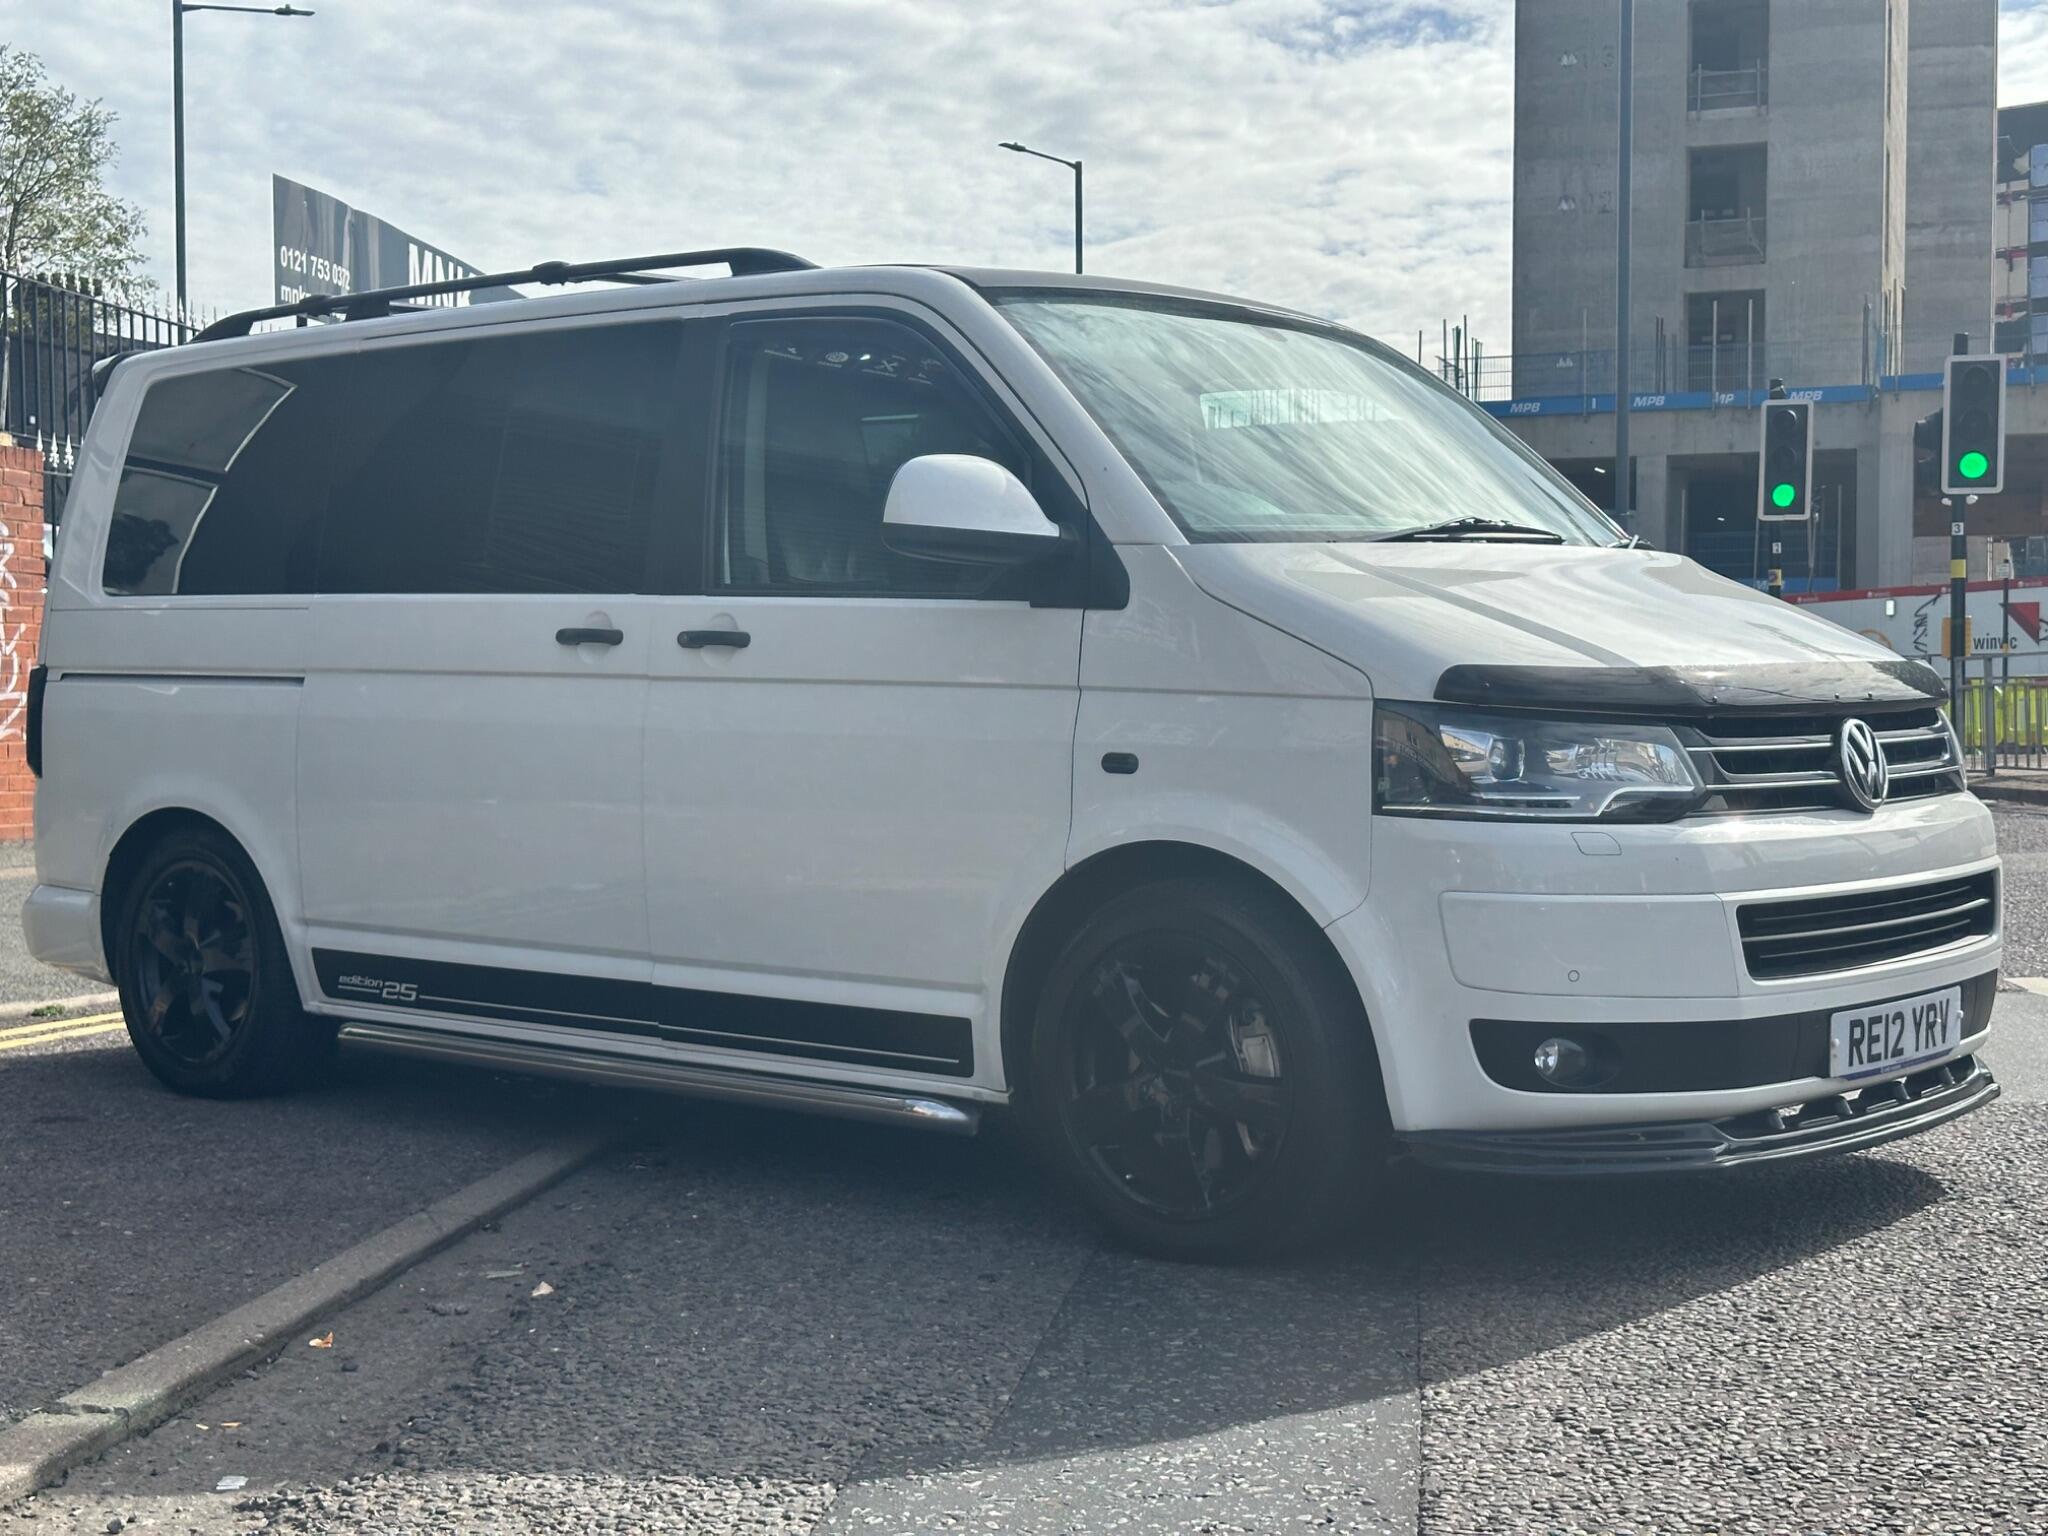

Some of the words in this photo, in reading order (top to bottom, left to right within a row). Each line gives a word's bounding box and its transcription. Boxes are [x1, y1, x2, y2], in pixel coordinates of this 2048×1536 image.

[281, 245, 308, 274] 0121
[310, 256, 331, 281] 753
[332, 264, 350, 290] 0372
[281, 284, 312, 304] mnk
[1633, 395, 1665, 407] MPB
[1789, 390, 1823, 401] MPB
[1510, 402, 1541, 413] MPB
[1954, 523, 1961, 534] 3
[1973, 632, 2017, 650] winc
[338, 975, 383, 988] edition
[382, 981, 418, 1001] 25
[1848, 1011, 1905, 1067] RE12
[1912, 998, 1950, 1052] YRV
